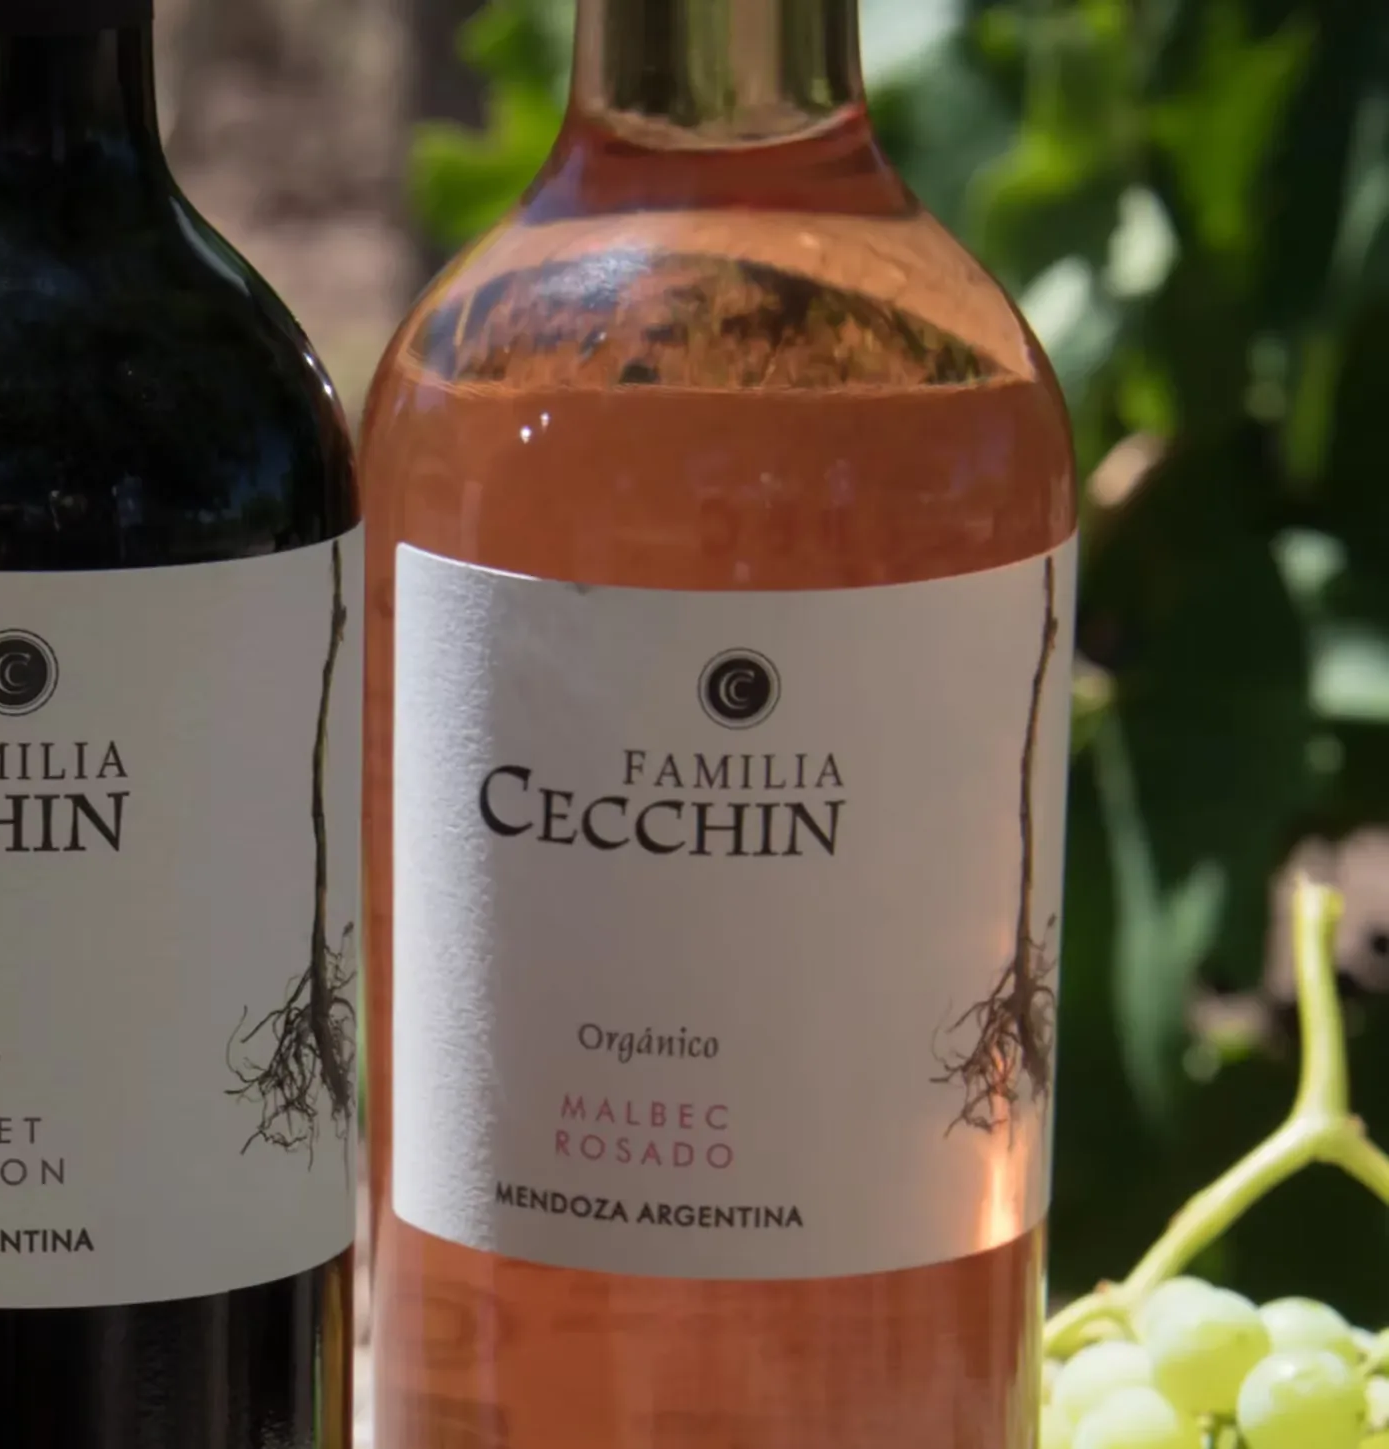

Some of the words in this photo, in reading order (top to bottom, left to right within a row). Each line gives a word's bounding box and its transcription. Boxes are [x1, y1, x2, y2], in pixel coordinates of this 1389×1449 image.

[623, 749, 845, 788] FAMILIA
[478, 765, 846, 857] CECCHIN
[577, 1024, 720, 1064] Orgánico
[561, 1093, 730, 1131] MALBEC
[555, 1130, 735, 1170] ROSADO
[495, 1182, 628, 1223] MENDOZA
[637, 1204, 803, 1228] ARGENTINA
